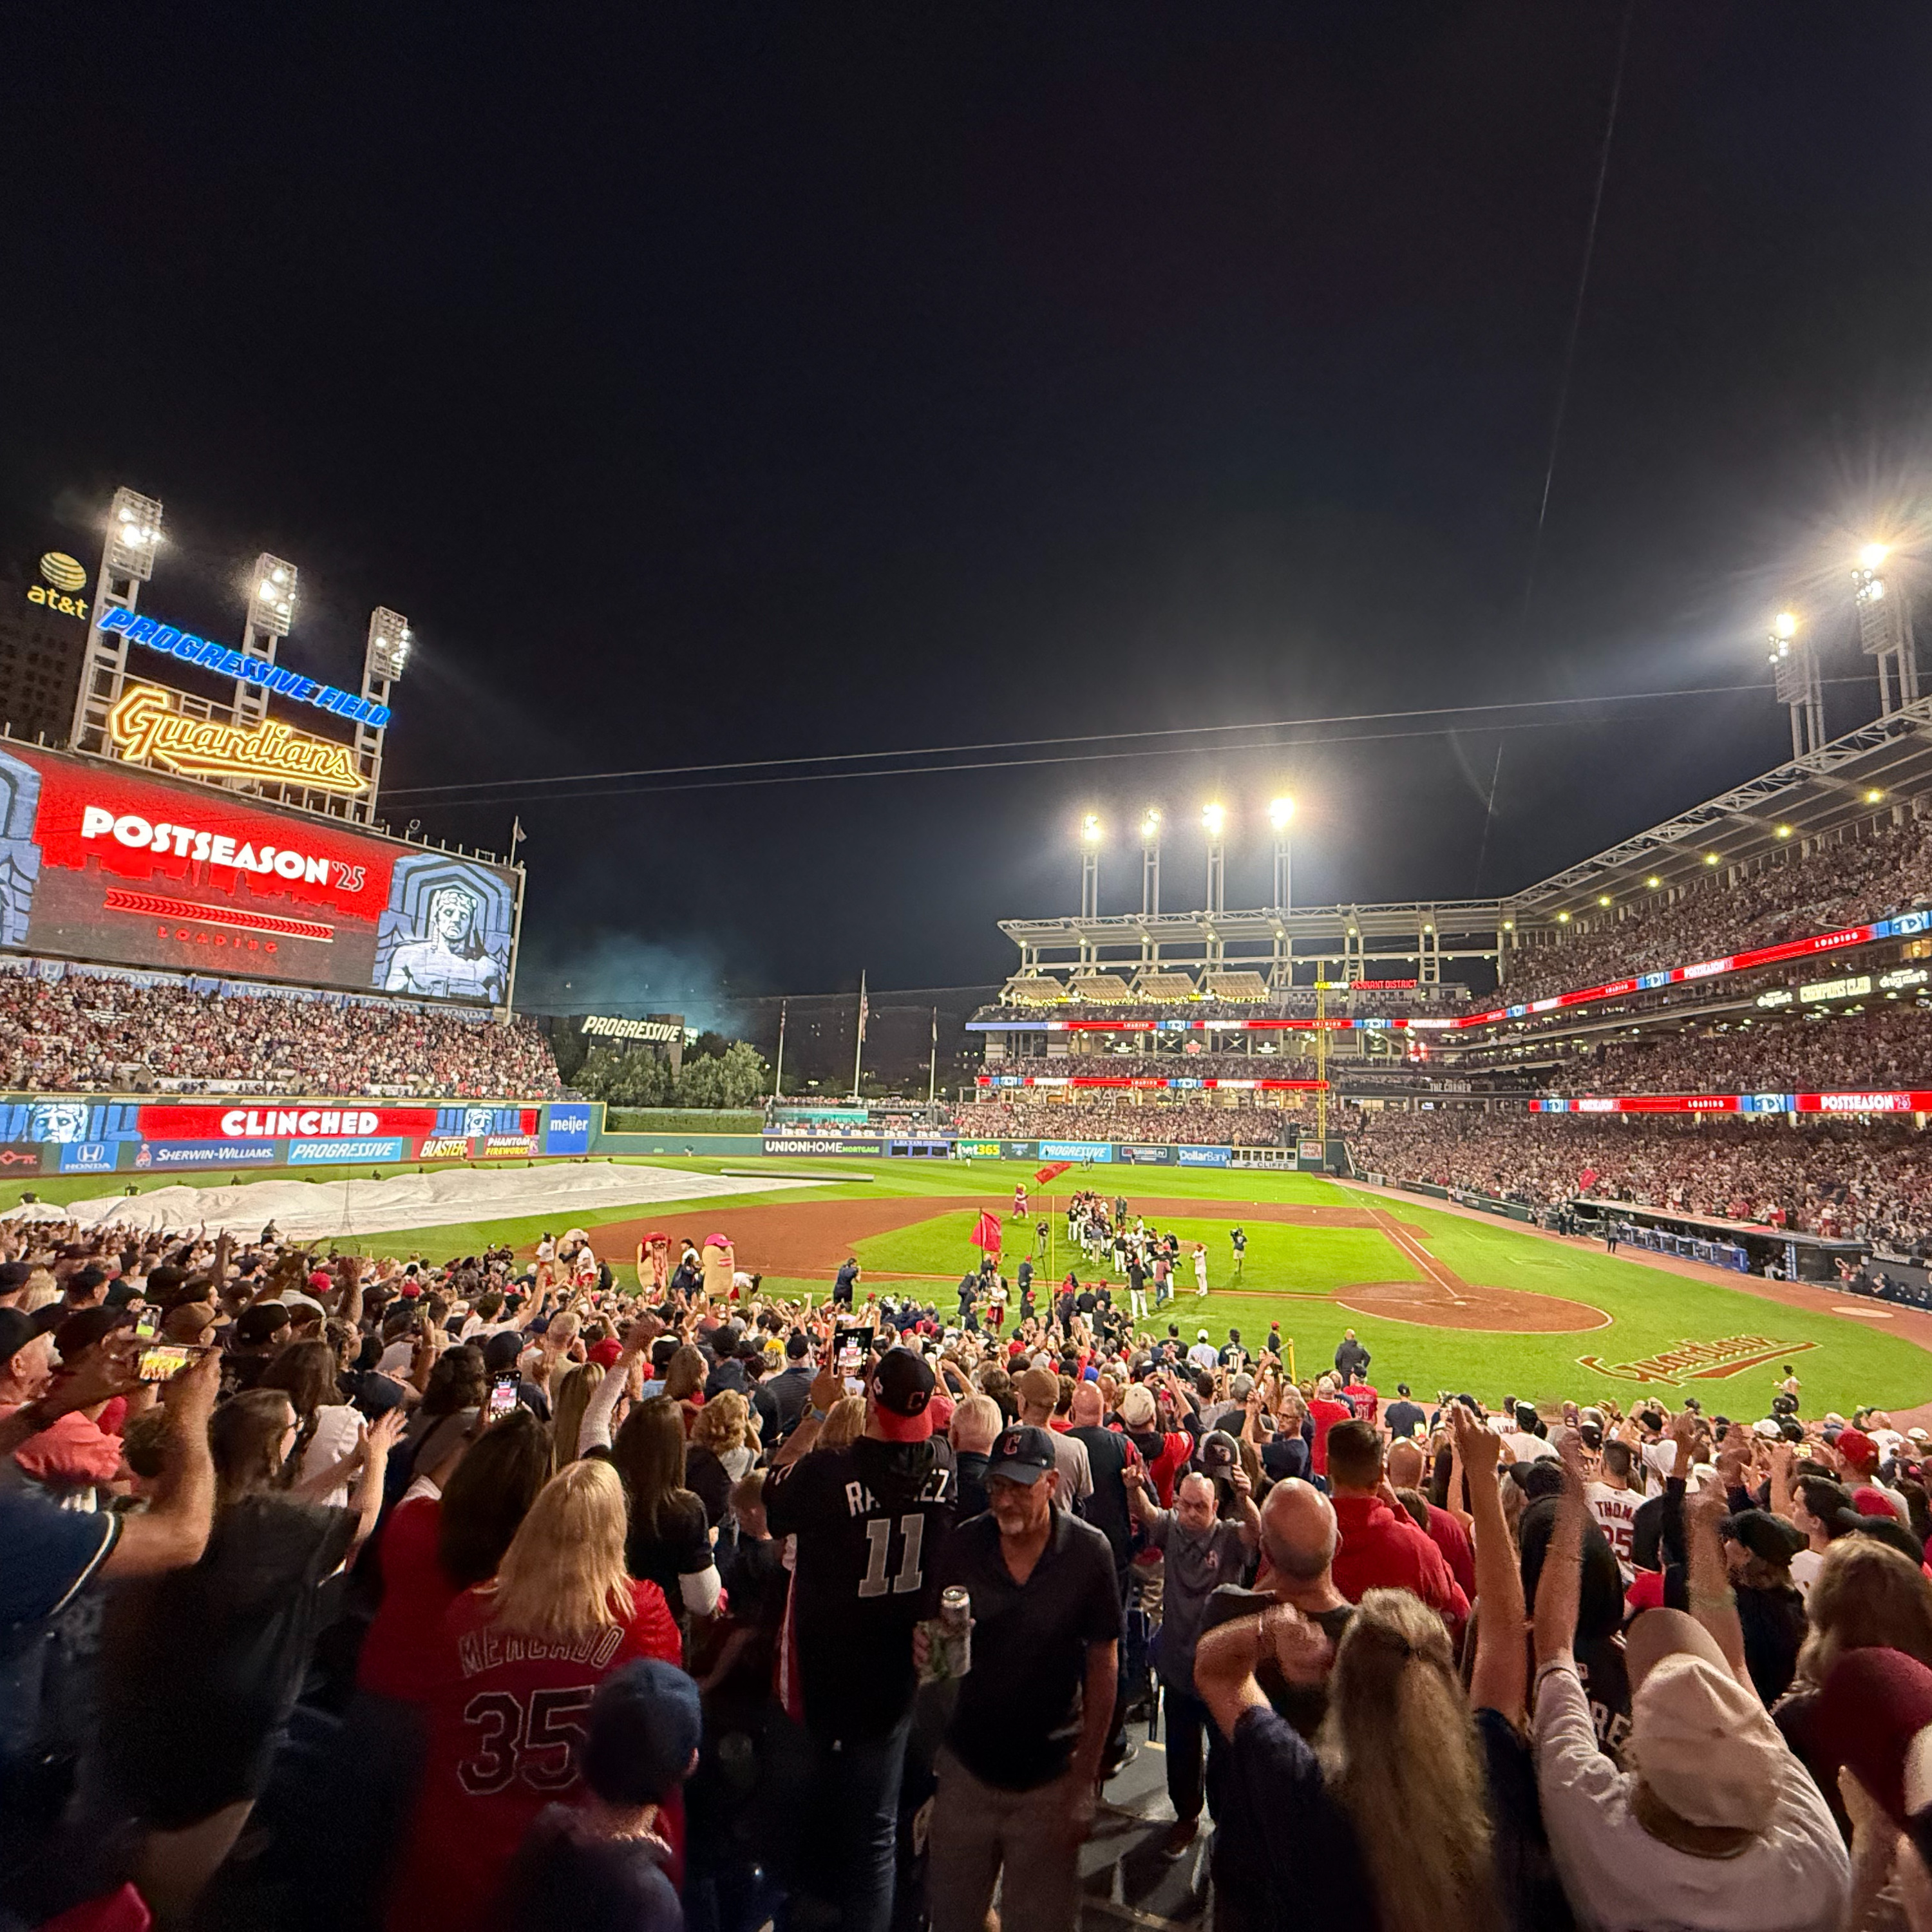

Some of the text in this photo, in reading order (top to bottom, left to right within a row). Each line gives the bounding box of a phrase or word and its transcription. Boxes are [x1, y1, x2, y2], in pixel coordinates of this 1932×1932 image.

[27, 585, 89, 620] at&t
[96, 606, 392, 728] PROGRESSIVE FIELD
[109, 685, 366, 791] Guardians
[80, 805, 366, 893] POSTSEASON '25
[157, 925, 278, 954] LOADING
[1814, 931, 1859, 949] LOADING
[1385, 980, 1417, 989] DISTRICT
[581, 1015, 682, 1043] PROGRESSIVE
[1821, 1095, 1895, 1110] POSTSEASON
[220, 1110, 379, 1137] CLINCHED
[550, 1115, 589, 1135] meijer
[292, 1141, 395, 1158] PROGRESSIVE
[419, 1140, 467, 1157] BLASTER
[486, 1147, 529, 1156] FIREWORKS
[488, 1137, 531, 1146] PHANTOM
[842, 1145, 880, 1153] MORTGAGE
[957, 1143, 999, 1155] bet365
[1041, 1144, 1107, 1157] PROGRESSIVE
[65, 1162, 111, 1170] HONDA
[1576, 1333, 1803, 1387] Guardians
[1003, 1434, 1023, 1455] C
[1594, 1501, 1635, 1522] THOM
[858, 1513, 925, 1598] 11
[457, 1684, 596, 1795] 35
